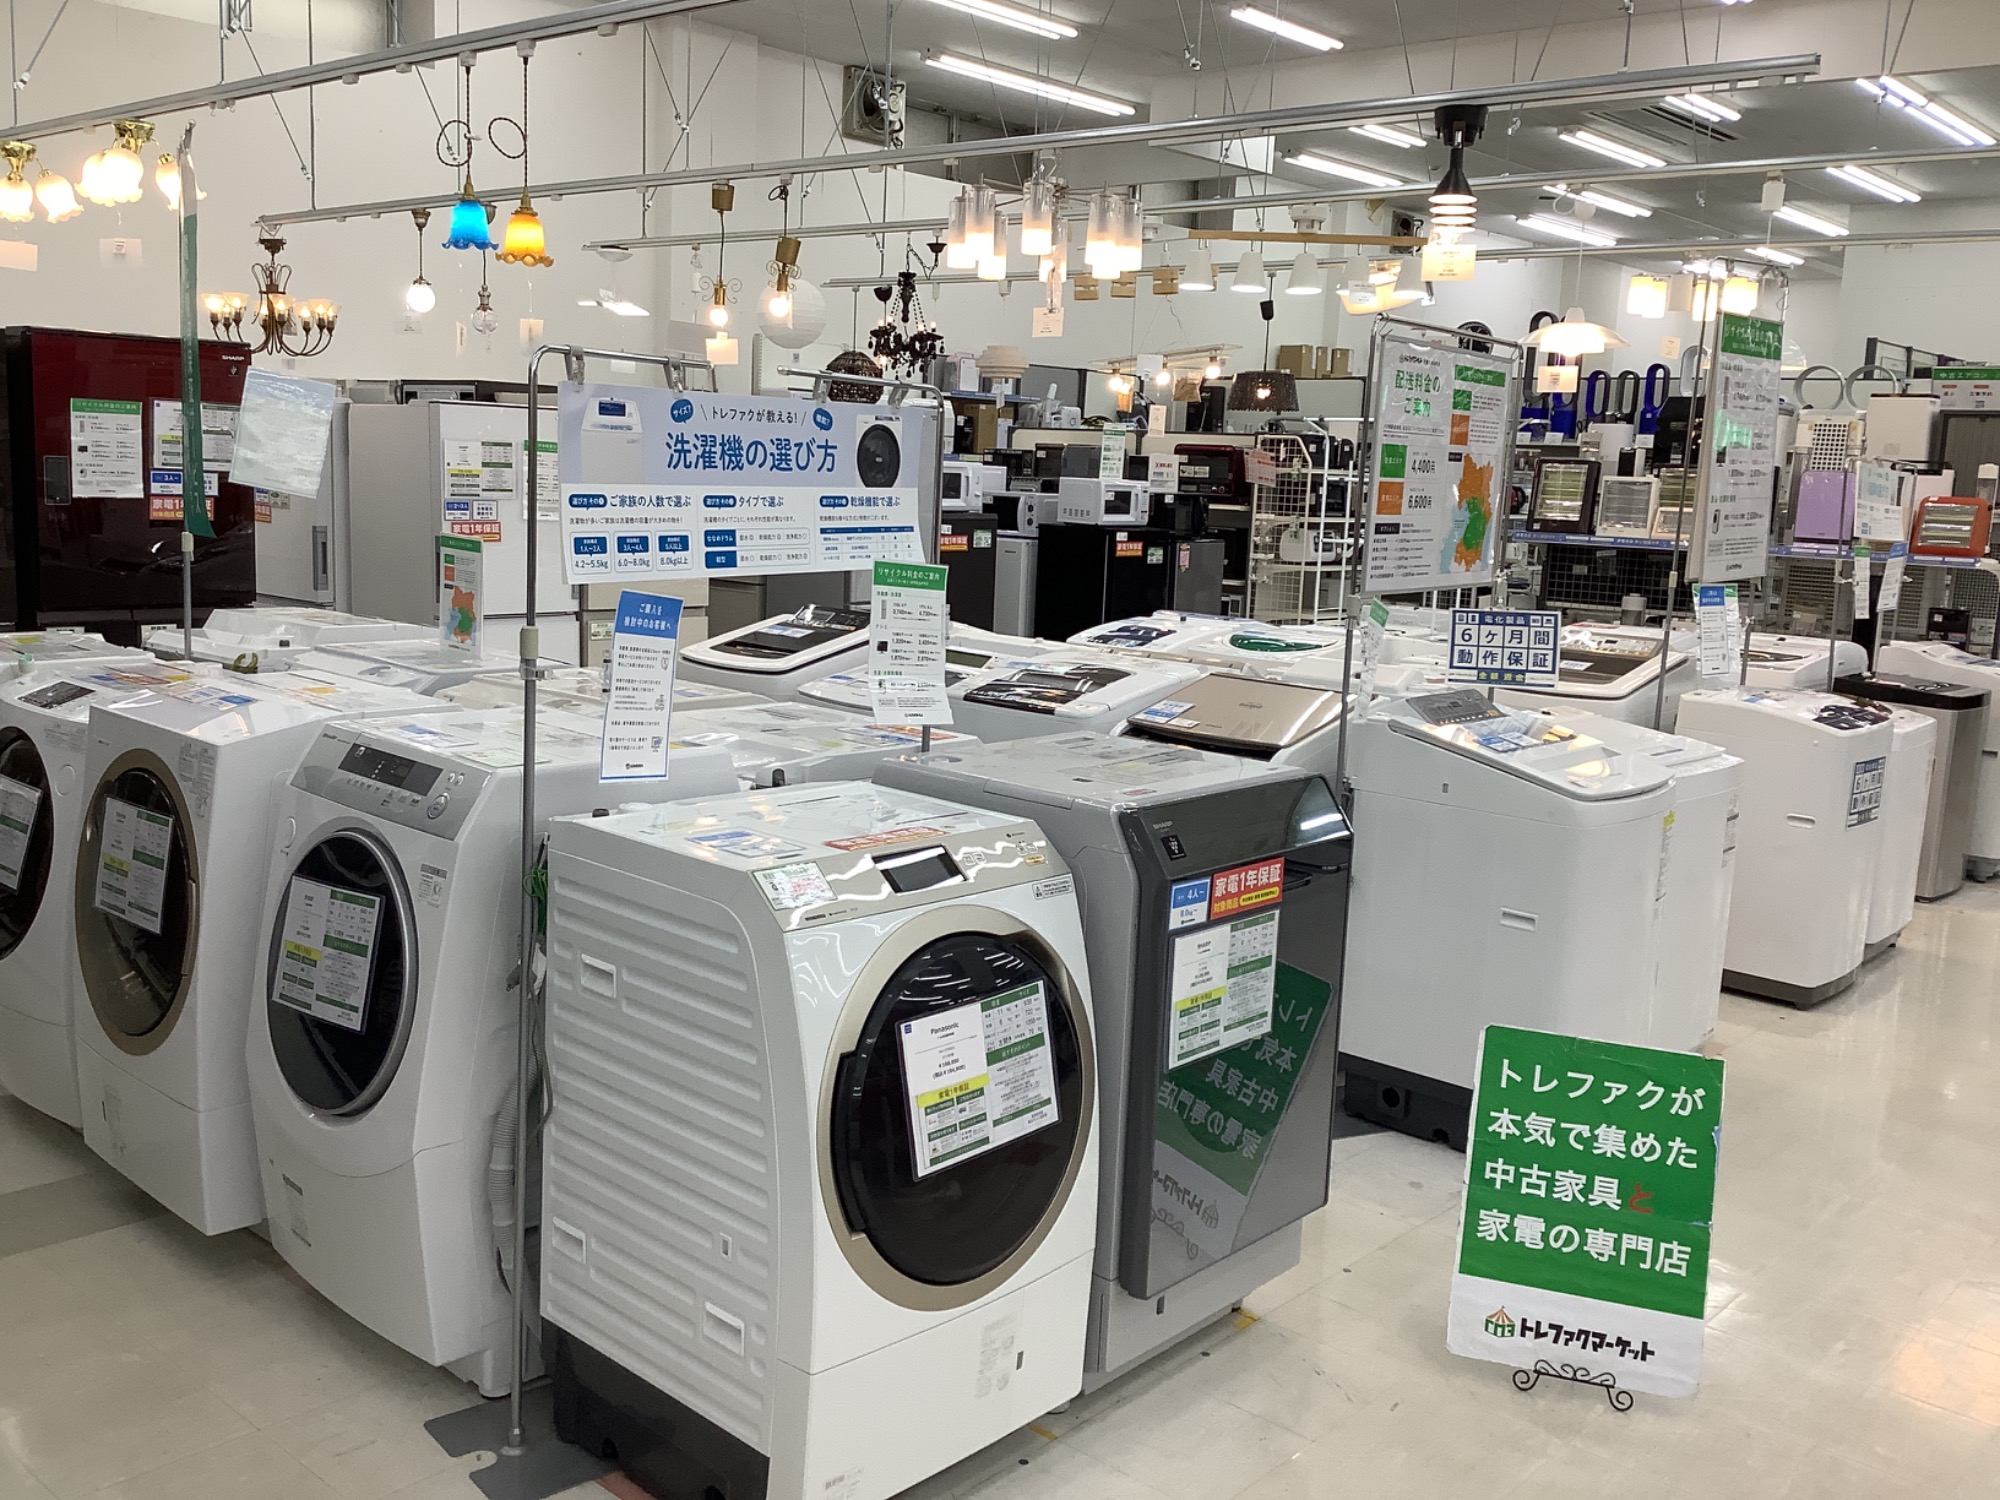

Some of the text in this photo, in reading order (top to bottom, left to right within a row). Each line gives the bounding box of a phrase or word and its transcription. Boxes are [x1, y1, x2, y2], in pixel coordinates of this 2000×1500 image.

[1395, 370, 1440, 393] 配送料金の
[712, 405, 797, 424] トレファクが教える!
[665, 432, 838, 474] 洗濯機の選び方
[610, 494, 691, 508] ご家族の人数で選ぶ
[739, 495, 784, 508] タイプで選ぶ
[850, 495, 901, 508] 乾燥機能で選ぶ
[878, 567, 940, 581] リサイクル料金のご案内
[1484, 614, 1525, 625] 電化製品
[1456, 649, 1549, 668] 動作保証
[1215, 863, 1281, 897] 家電1年保証
[930, 1022, 960, 1035] Panasonic
[1500, 1058, 1706, 1116] トレファクが
[1487, 1107, 1698, 1169] 本気で集めた
[1484, 1158, 1653, 1214] 中古家具と
[1476, 1208, 1692, 1277] 家電の専門店
[1520, 1317, 1655, 1362] トレファクマーケット
